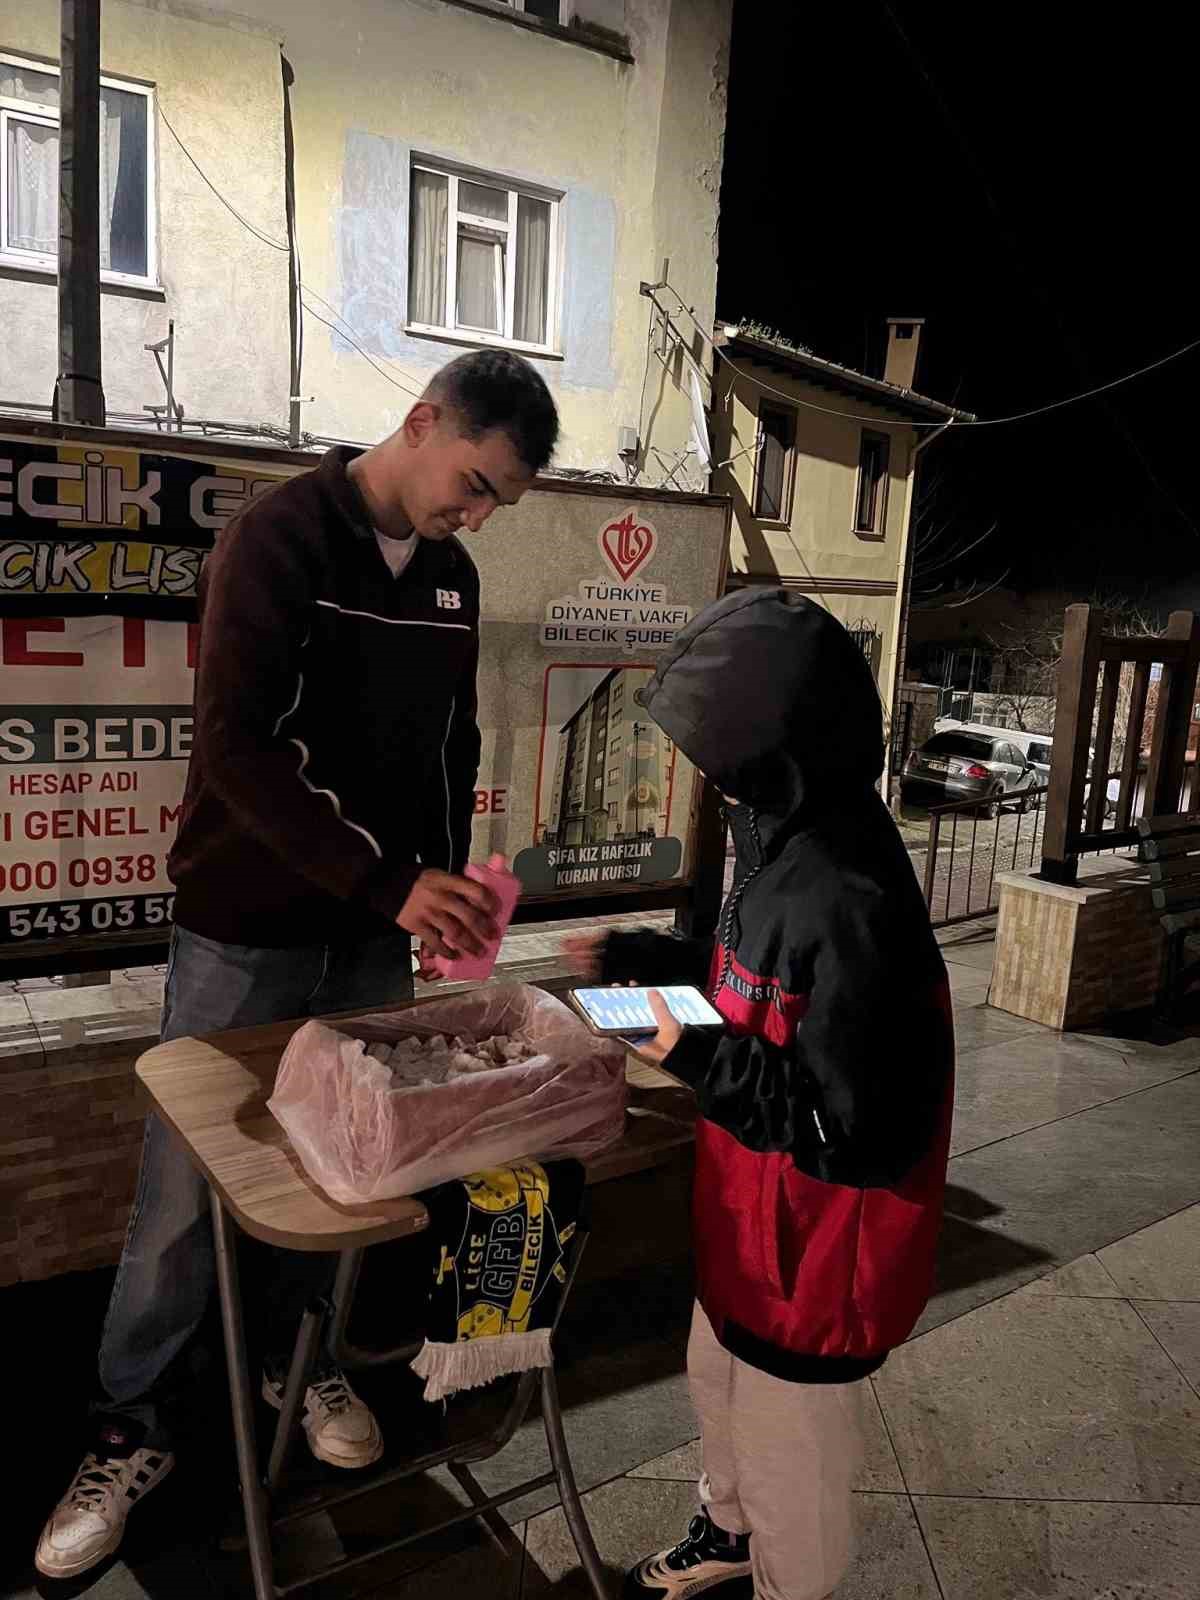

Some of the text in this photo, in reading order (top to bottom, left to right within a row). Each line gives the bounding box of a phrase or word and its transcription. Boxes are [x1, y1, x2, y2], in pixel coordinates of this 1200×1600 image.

[110, 543, 206, 594] LIS
[584, 582, 662, 602] TÜRKİYE
[551, 601, 688, 624] DİYANET VAKFI
[545, 622, 619, 642] BİLECİK
[9, 771, 138, 796] HESAP ADI
[24, 806, 149, 840] GENEL
[579, 846, 599, 862] KIZ
[602, 842, 652, 860] HAFIZLIK
[69, 854, 156, 888] 0938
[557, 864, 640, 885] KURAN KURSU
[9, 905, 80, 937] 543
[91, 900, 135, 929] 03
